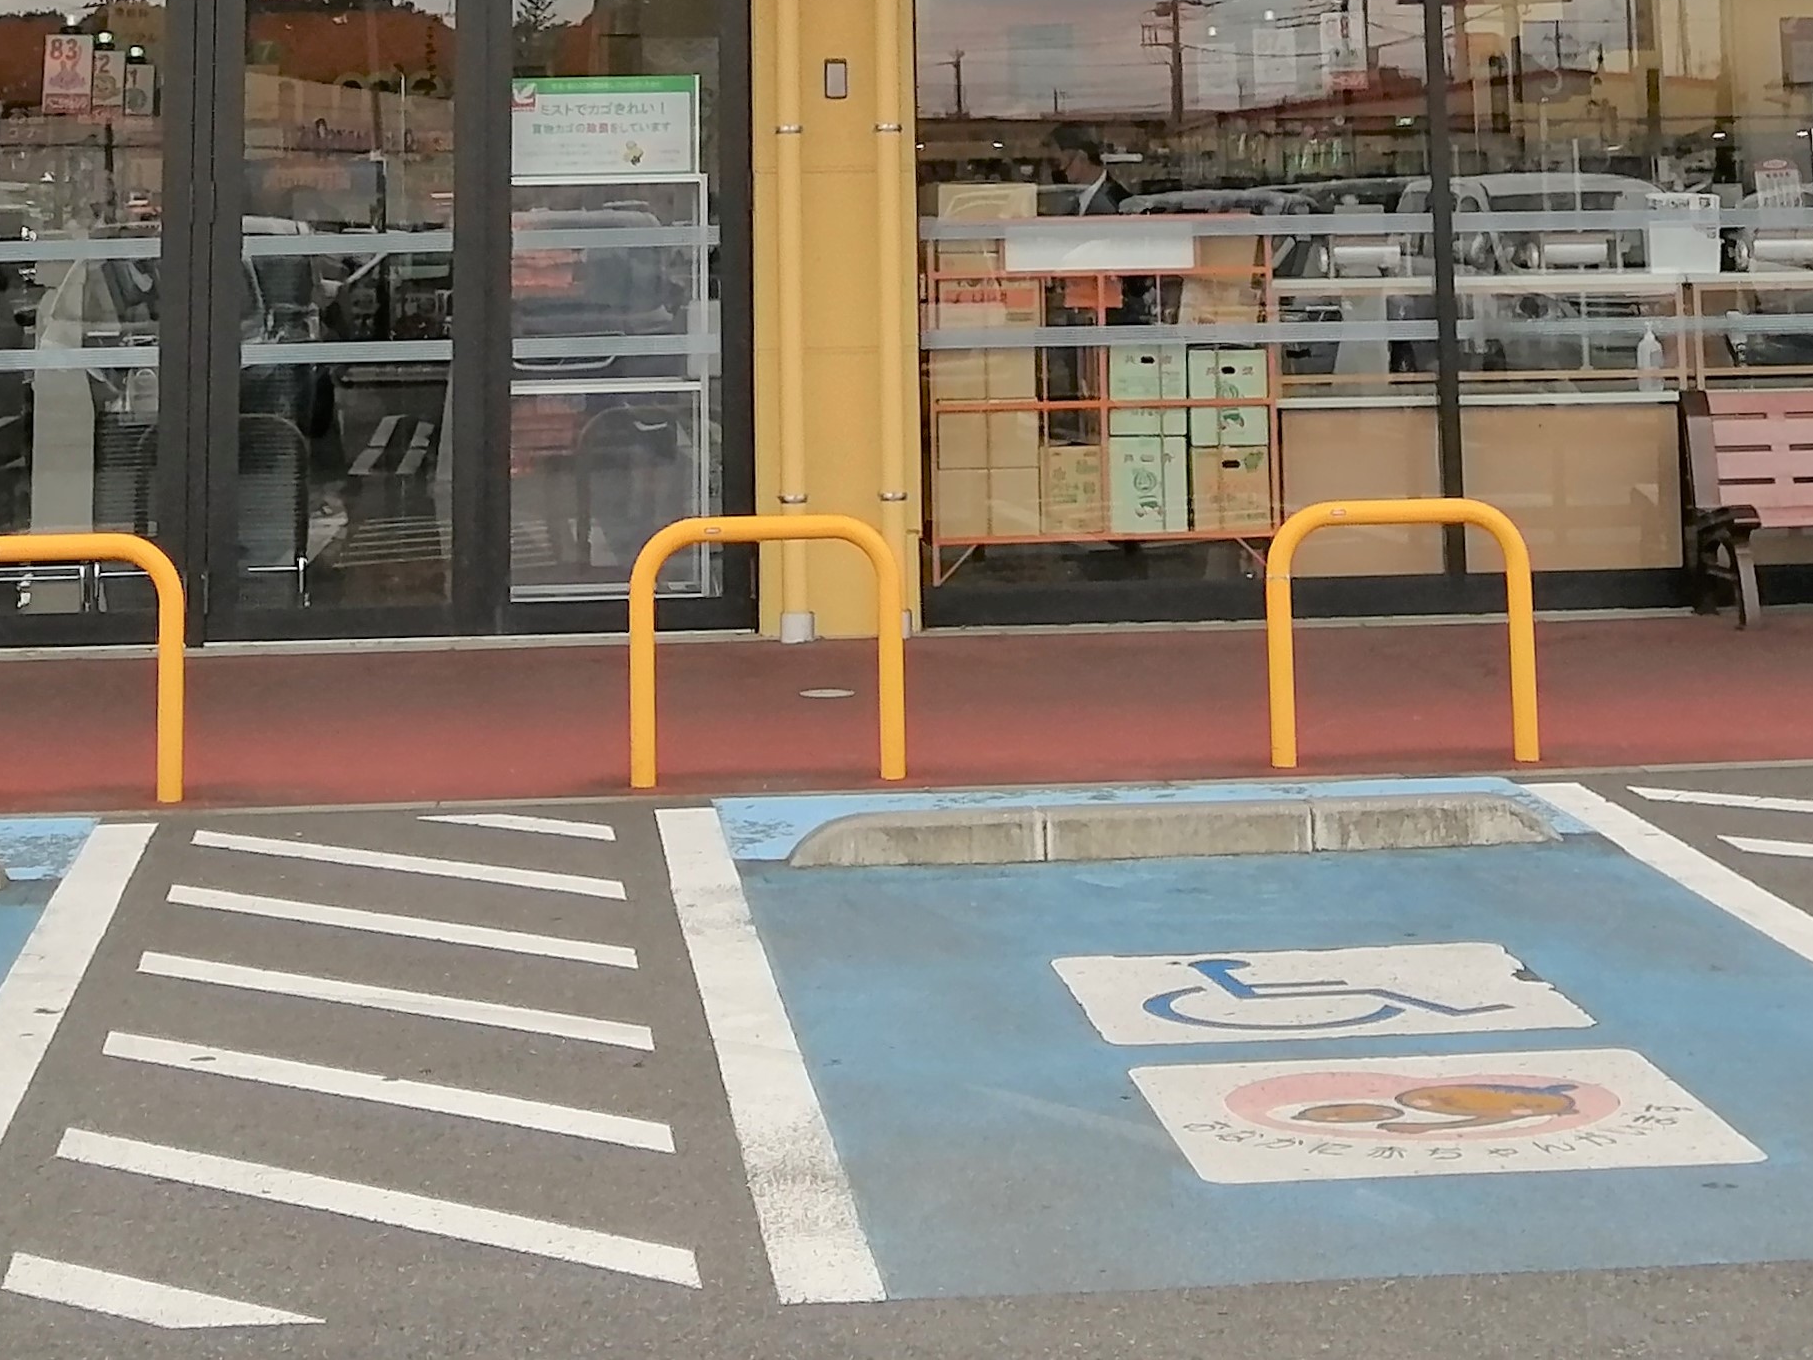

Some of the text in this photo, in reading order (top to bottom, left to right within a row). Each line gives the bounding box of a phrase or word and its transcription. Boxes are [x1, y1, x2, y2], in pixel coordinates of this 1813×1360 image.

[50, 38, 79, 61] 83
[1181, 1102, 1694, 1162] おなかに赤ちゃんがいます
